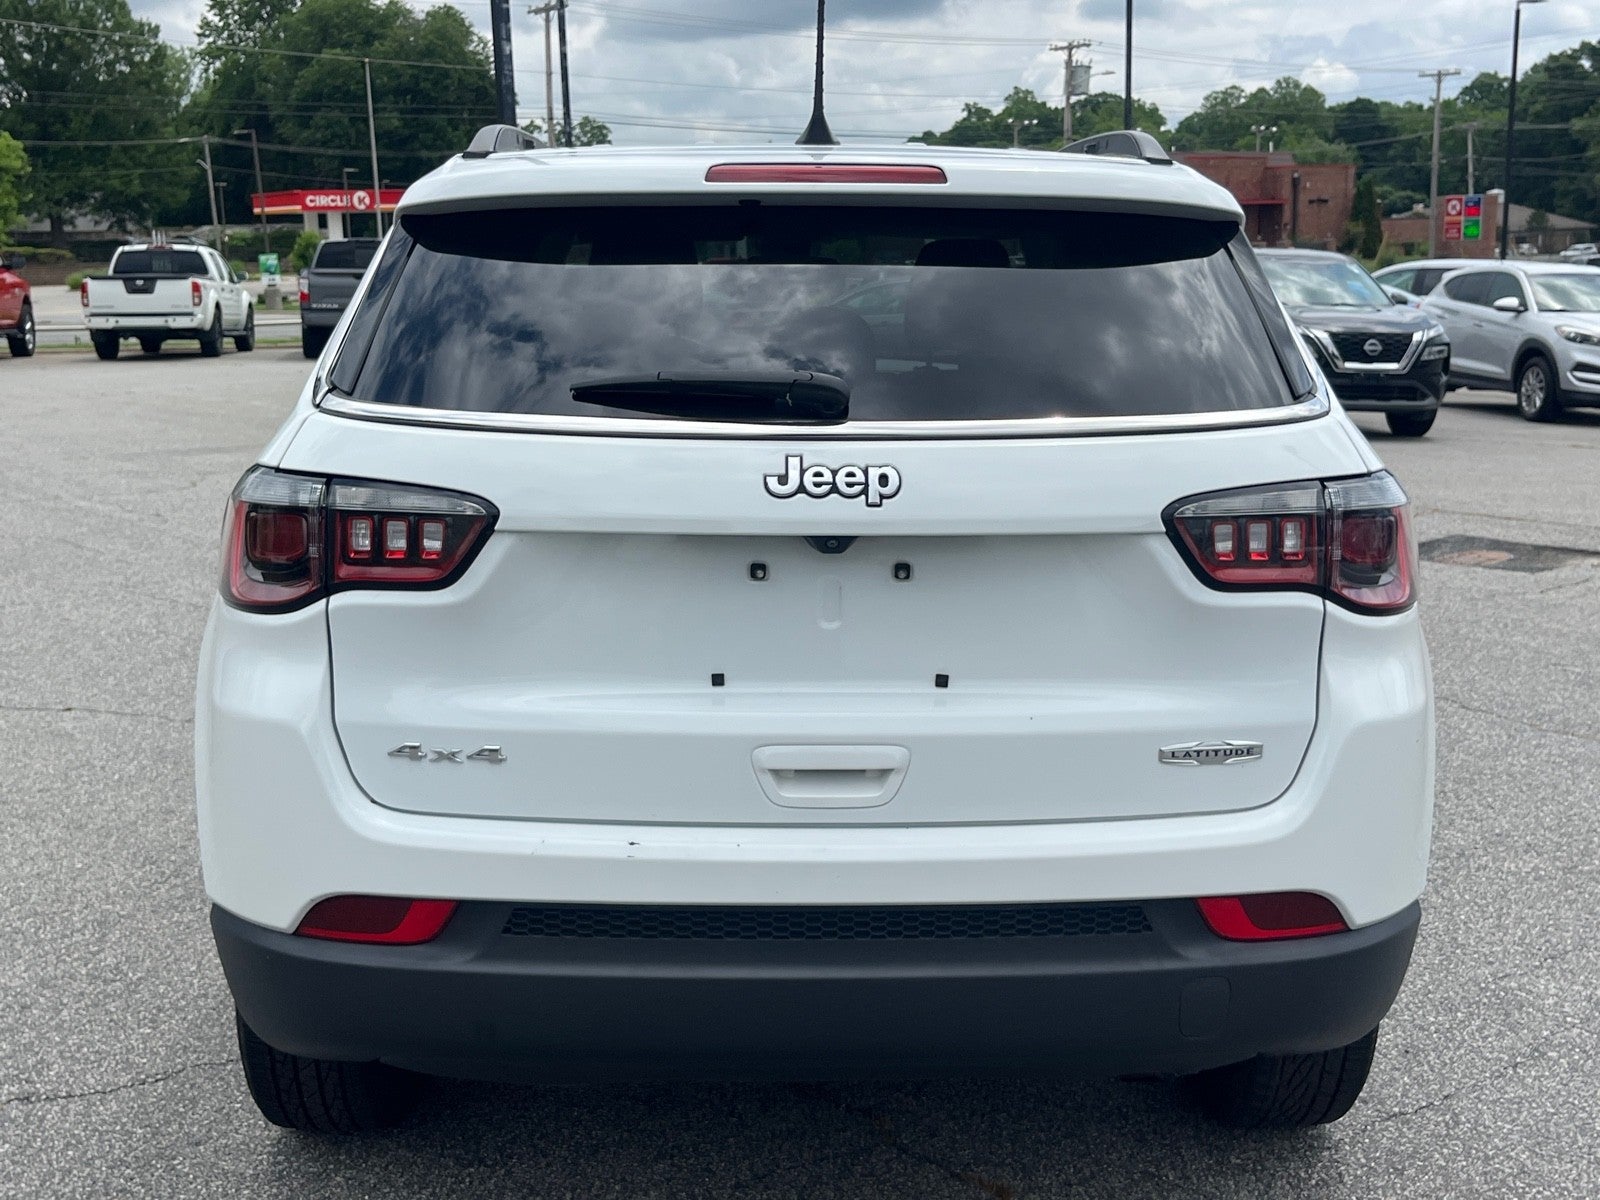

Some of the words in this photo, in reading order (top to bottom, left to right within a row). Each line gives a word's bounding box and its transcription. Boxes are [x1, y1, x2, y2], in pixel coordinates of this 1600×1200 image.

[305, 194, 351, 207] CIRCLE
[764, 454, 901, 507] Jeep
[1171, 747, 1255, 758] LATITUDE
